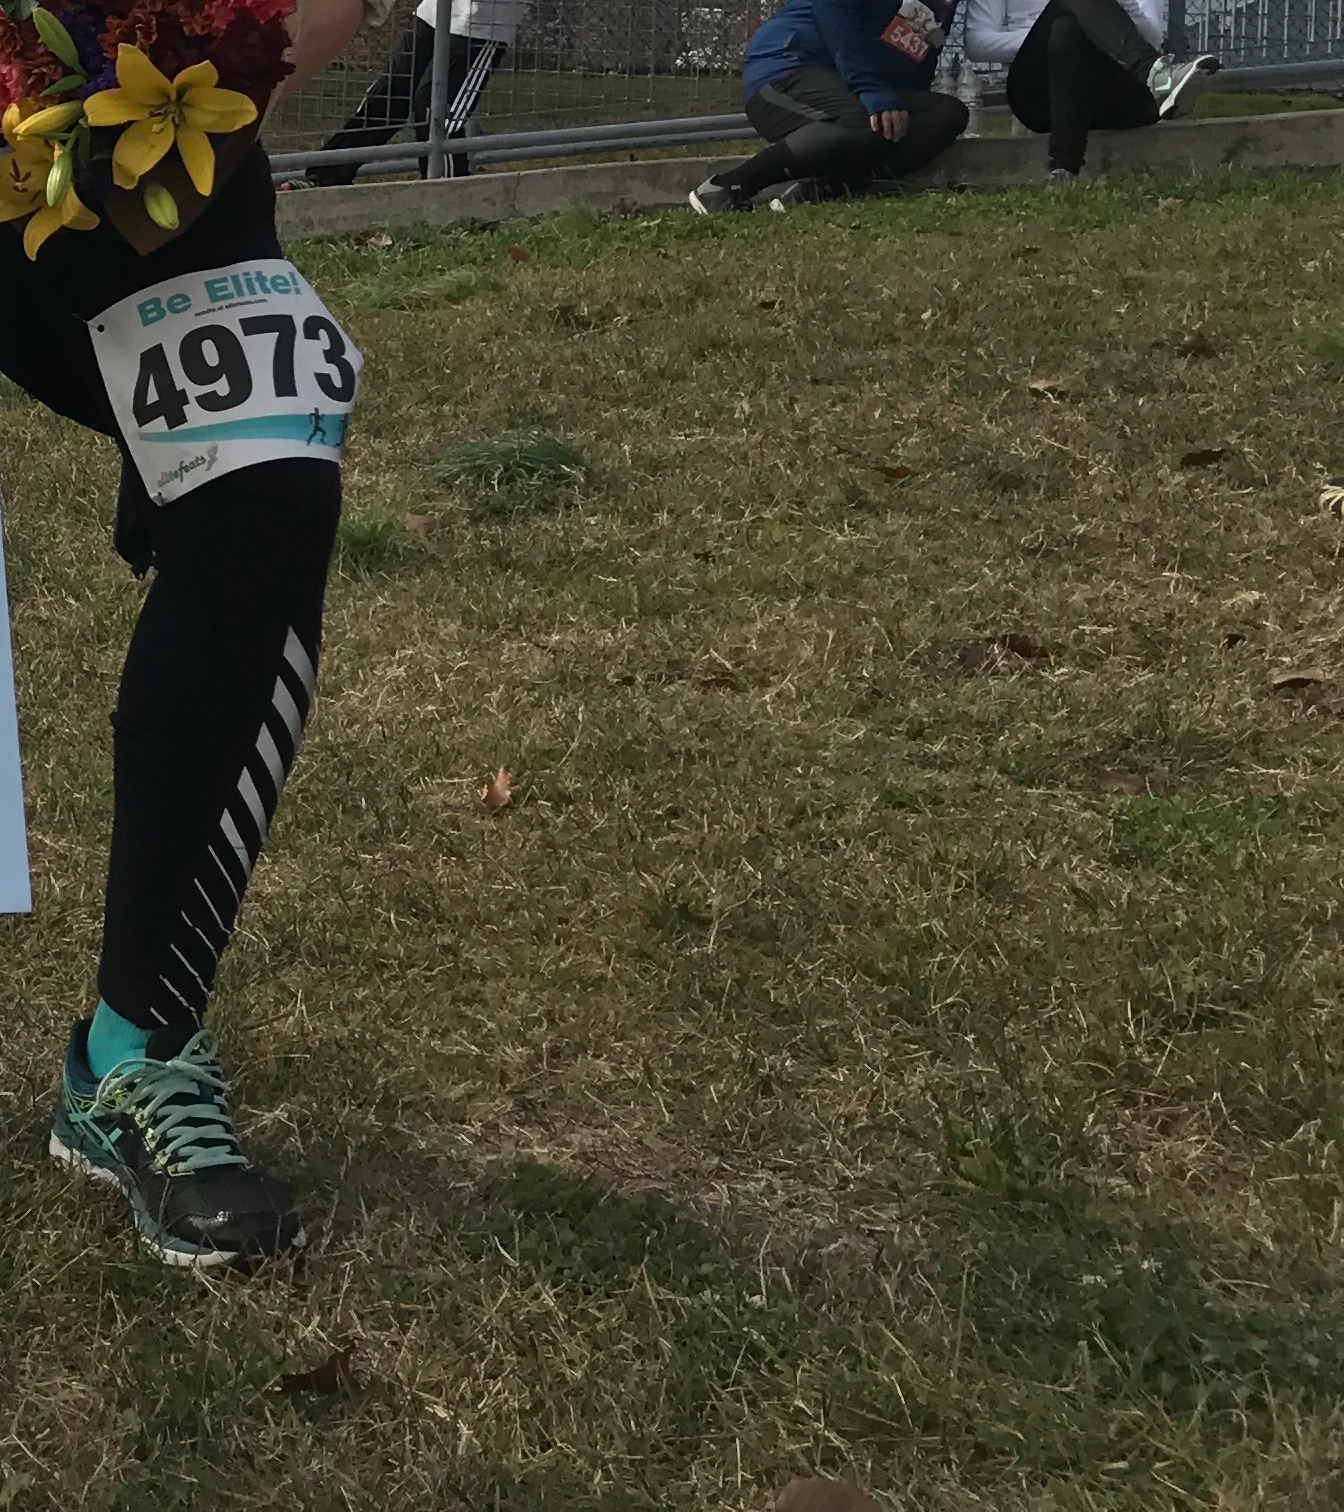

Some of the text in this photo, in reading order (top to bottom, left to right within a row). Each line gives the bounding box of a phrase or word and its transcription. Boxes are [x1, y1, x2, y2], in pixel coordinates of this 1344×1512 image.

[137, 293, 192, 327] Be
[203, 270, 302, 304] Elite!
[132, 313, 356, 431] 4973
